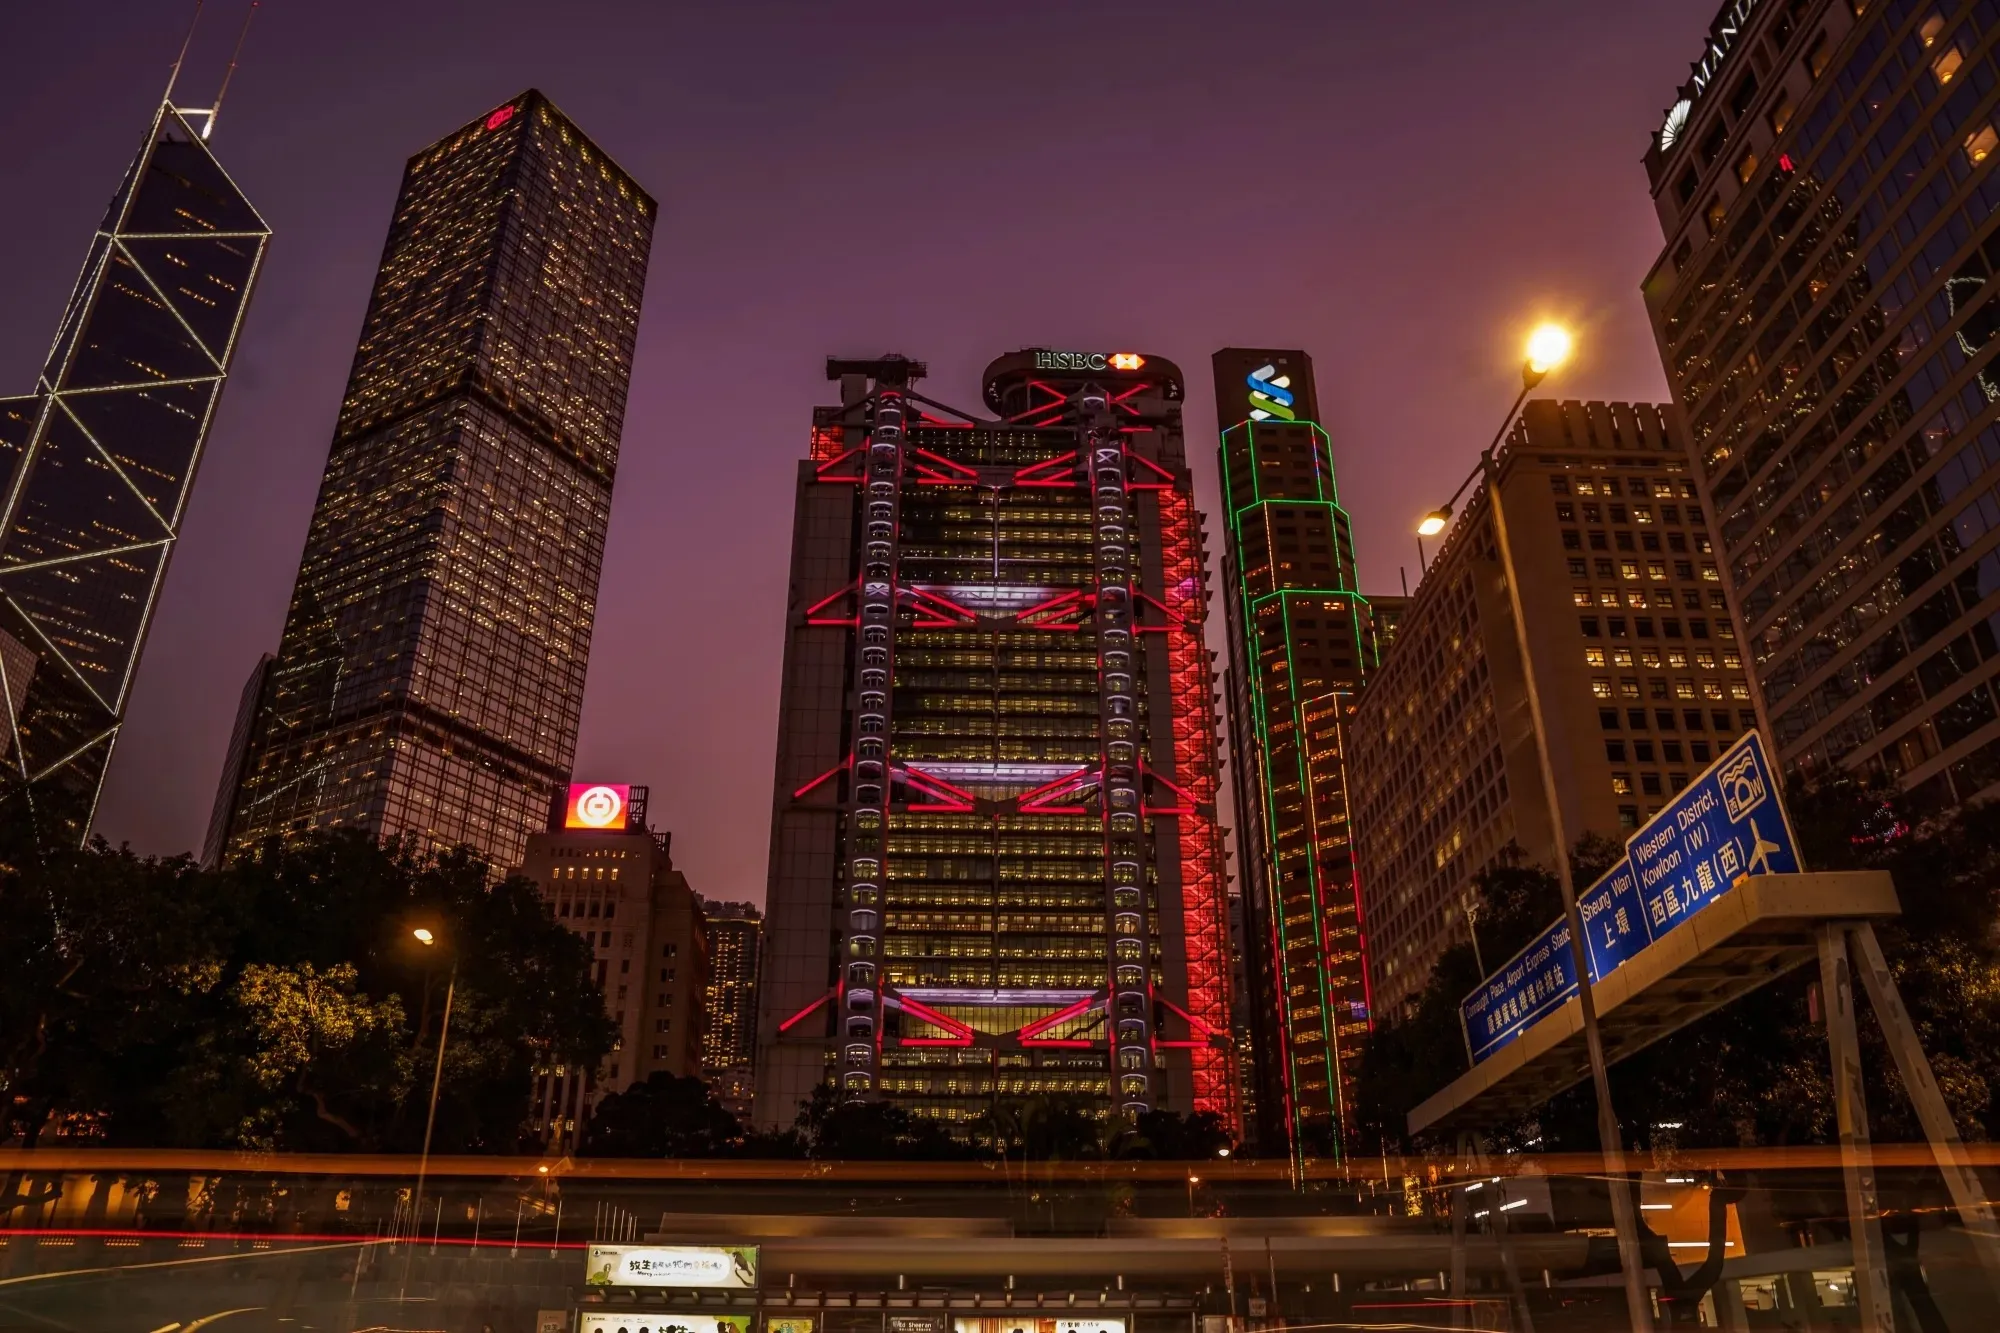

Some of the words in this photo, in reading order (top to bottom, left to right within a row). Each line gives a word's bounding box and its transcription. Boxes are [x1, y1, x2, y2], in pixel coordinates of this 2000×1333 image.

[1693, 0, 1757, 97] MAND
[1036, 352, 1106, 370] HSBC
[1635, 825, 1675, 865] Western
[1677, 788, 1719, 831] District,
[1641, 850, 1682, 889] Kowloon
[1684, 822, 1710, 856] (W)
[1582, 891, 1612, 922] Sheung
[1611, 874, 1632, 898] Wan
[1604, 907, 1631, 949] 上環
[1465, 993, 1490, 1019] Connaught
[1490, 981, 1507, 1000] Place,
[1506, 964, 1524, 986] Airport
[1525, 945, 1550, 973] Express
[1552, 927, 1571, 951] Statio
